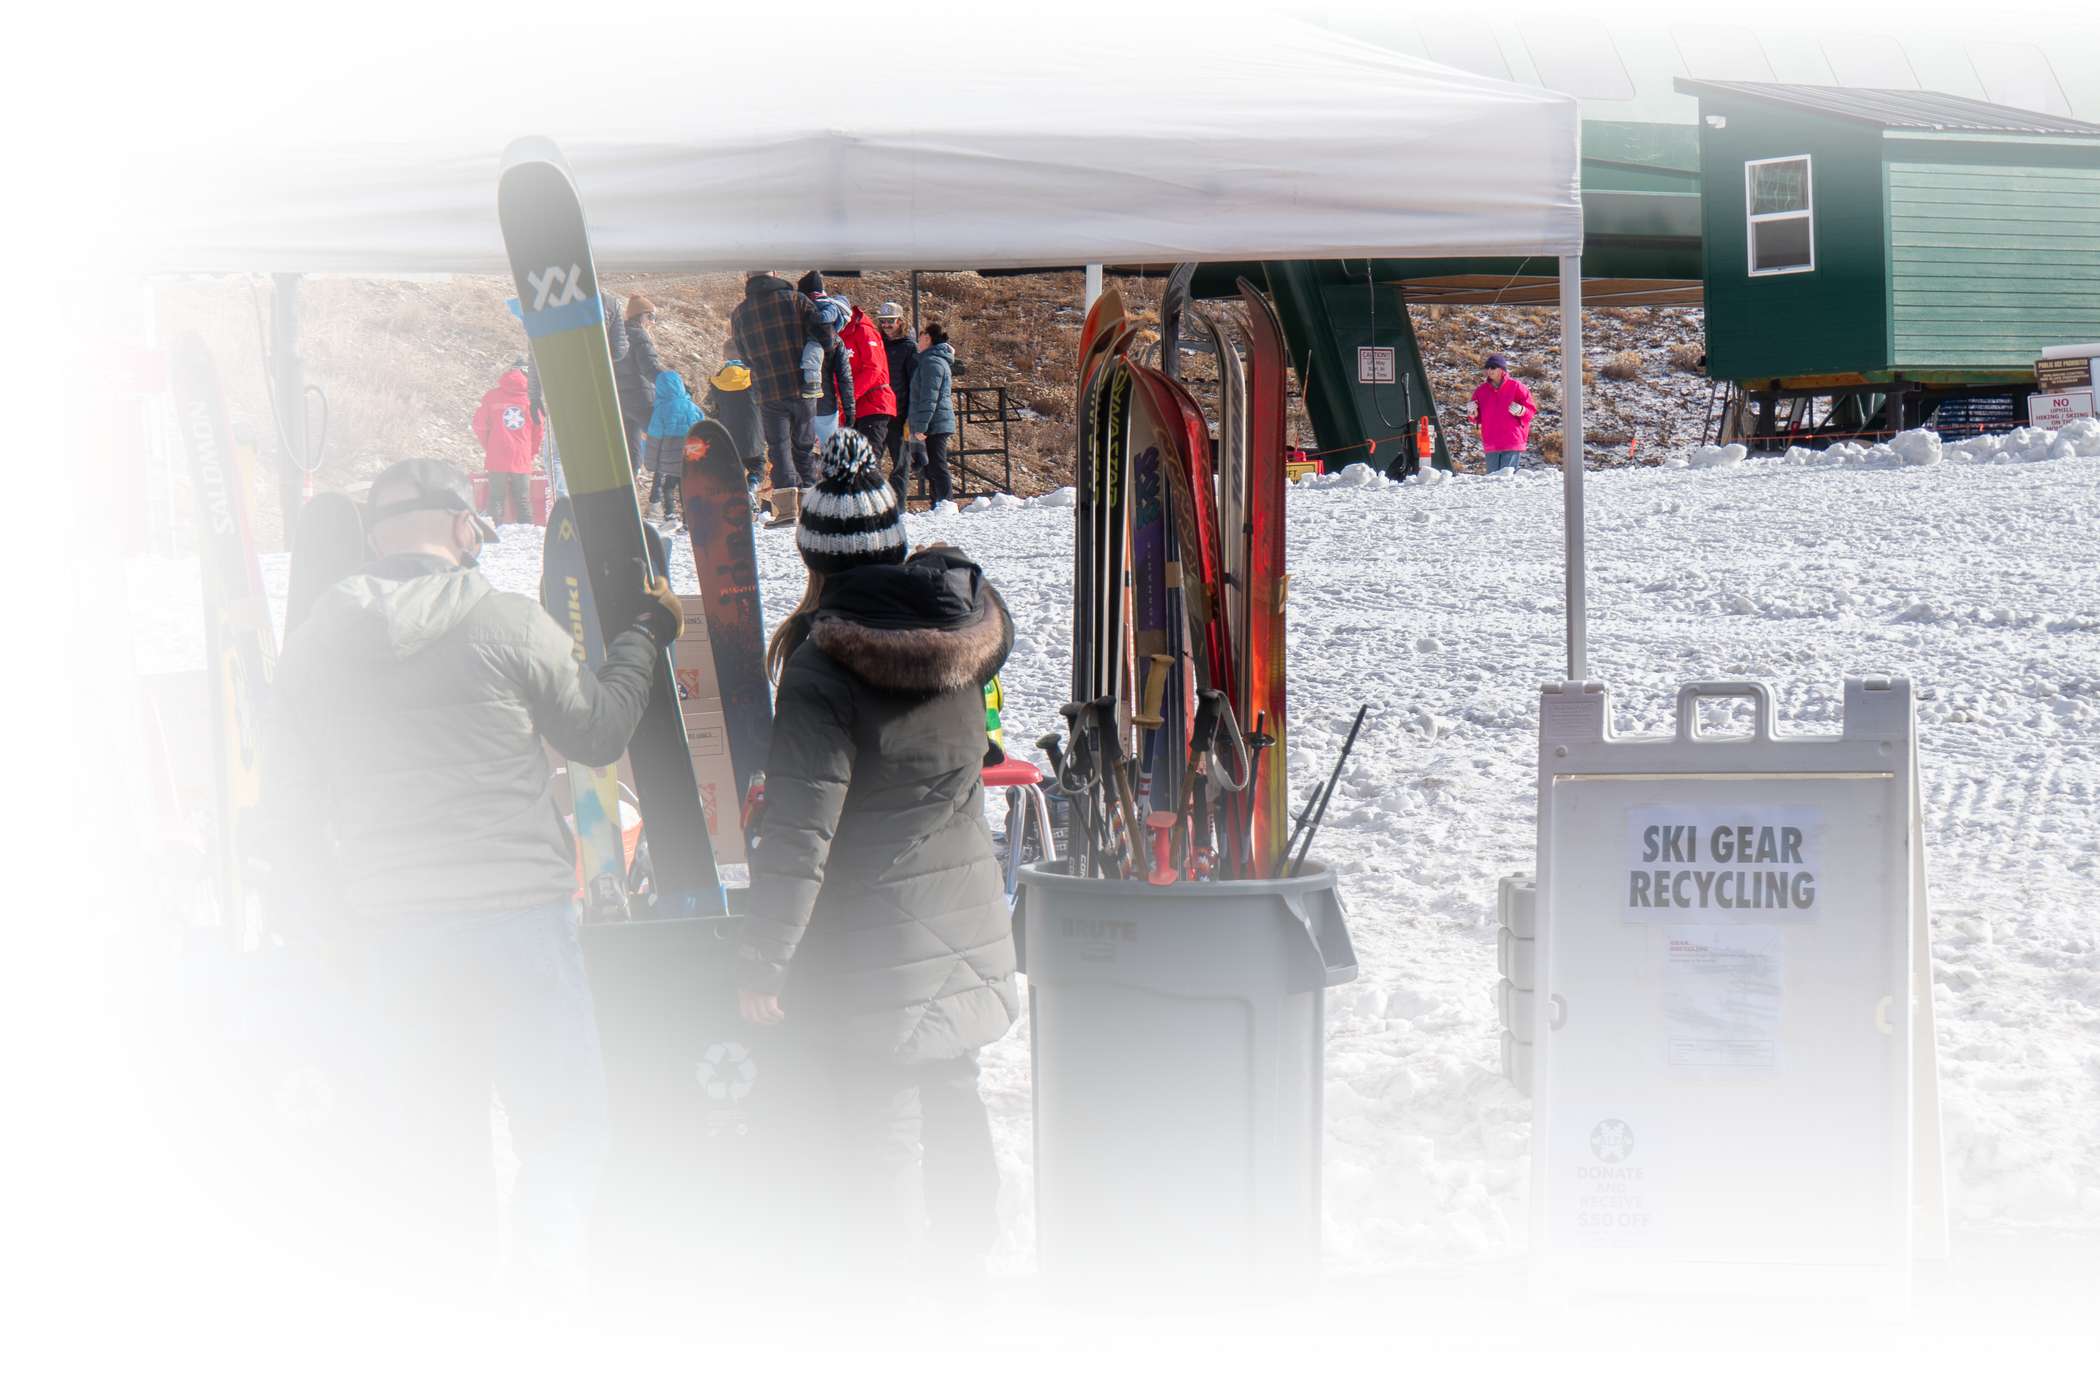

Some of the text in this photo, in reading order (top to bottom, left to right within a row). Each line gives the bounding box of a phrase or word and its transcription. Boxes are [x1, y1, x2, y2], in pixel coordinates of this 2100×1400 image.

[2053, 399, 2069, 407] NO
[191, 400, 236, 536] SALOMON
[1642, 825, 1804, 864] SKI GEAR
[1629, 870, 1815, 909] RECYCLING
[1576, 1167, 1645, 1180] DONATE
[1596, 1183, 1625, 1193] AND
